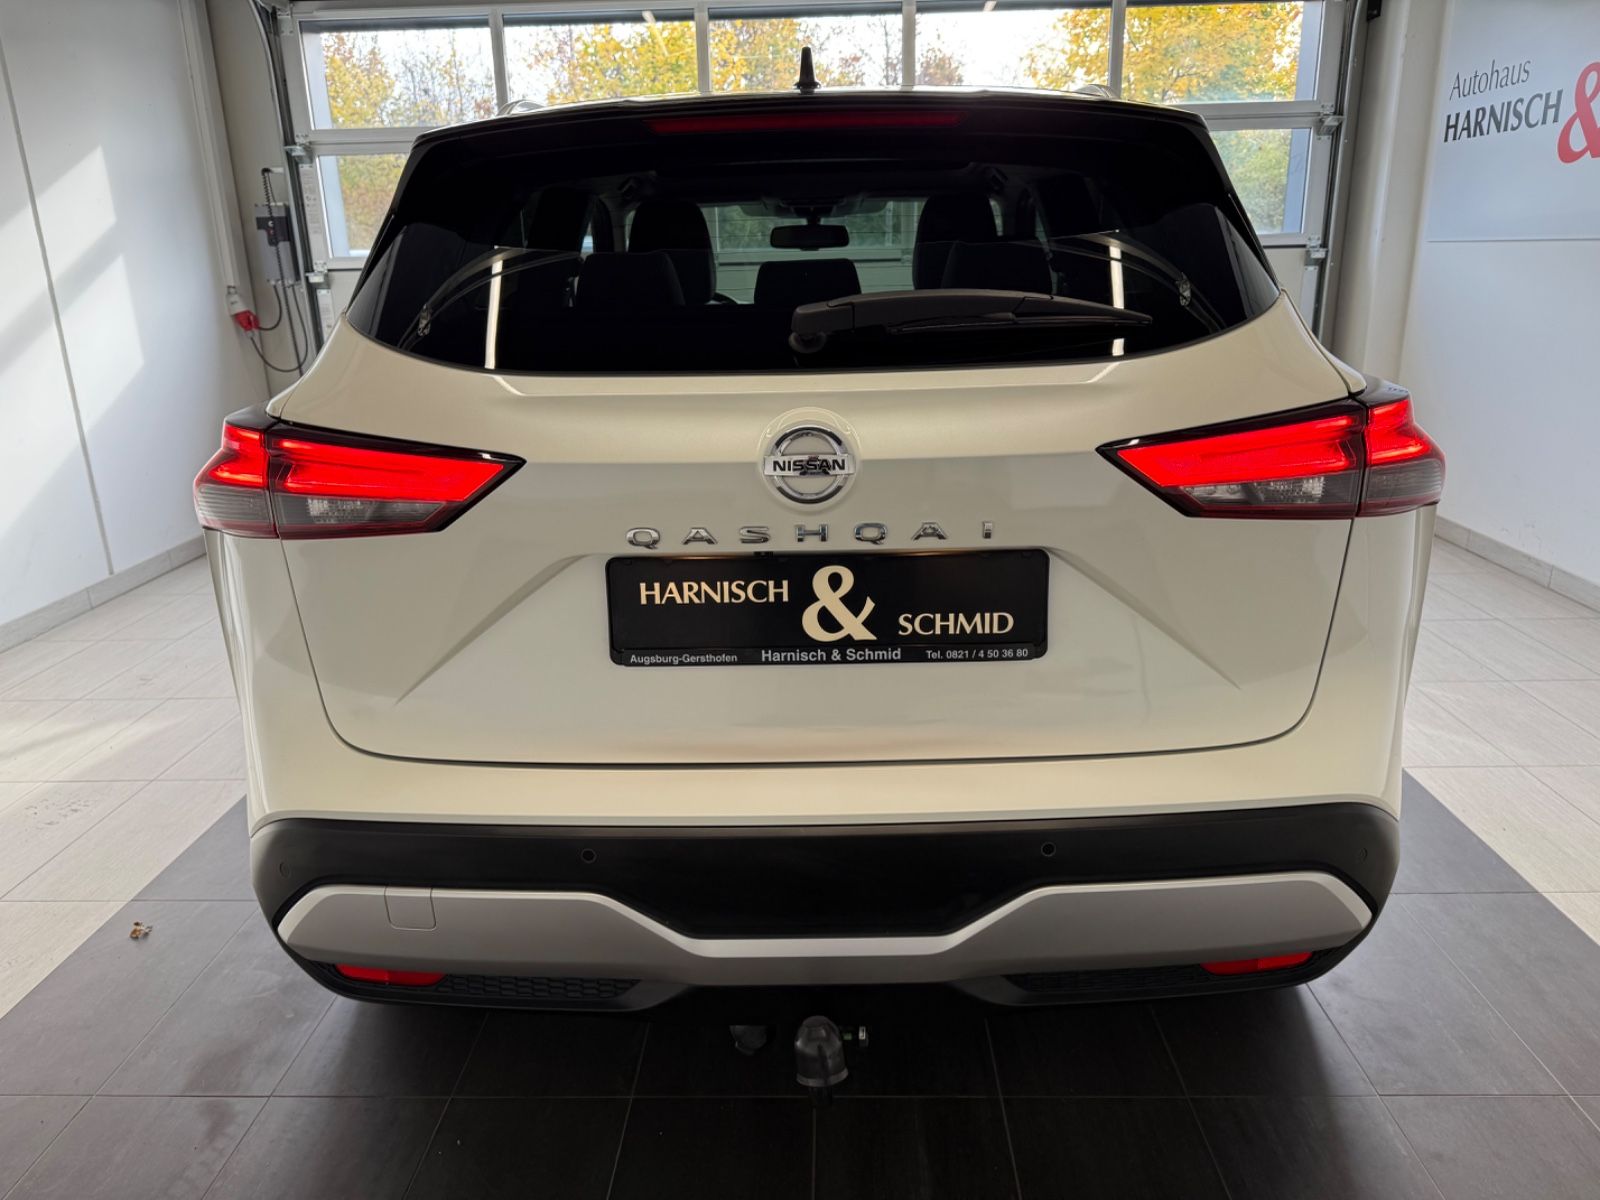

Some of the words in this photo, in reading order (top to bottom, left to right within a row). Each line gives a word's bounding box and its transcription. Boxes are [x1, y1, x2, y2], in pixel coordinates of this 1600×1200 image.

[1449, 59, 1531, 101] Autohaus
[1443, 89, 1563, 143] HARNISCH
[773, 458, 846, 472] NISSAN
[626, 521, 994, 549] QASHQAI
[639, 580, 789, 605] HARNISCH
[801, 565, 877, 642] &
[898, 612, 1014, 636] SCHMID
[630, 653, 738, 665] Augsburg-Gersthofen
[761, 649, 826, 662] Harnisch
[831, 649, 840, 661] &
[846, 648, 902, 661] Schmid
[925, 650, 943, 659] Tel.
[946, 650, 969, 660] 0821
[978, 649, 985, 658] 4
[987, 649, 999, 659] 50
[1002, 649, 1014, 658] 36
[1016, 648, 1028, 658] 80
